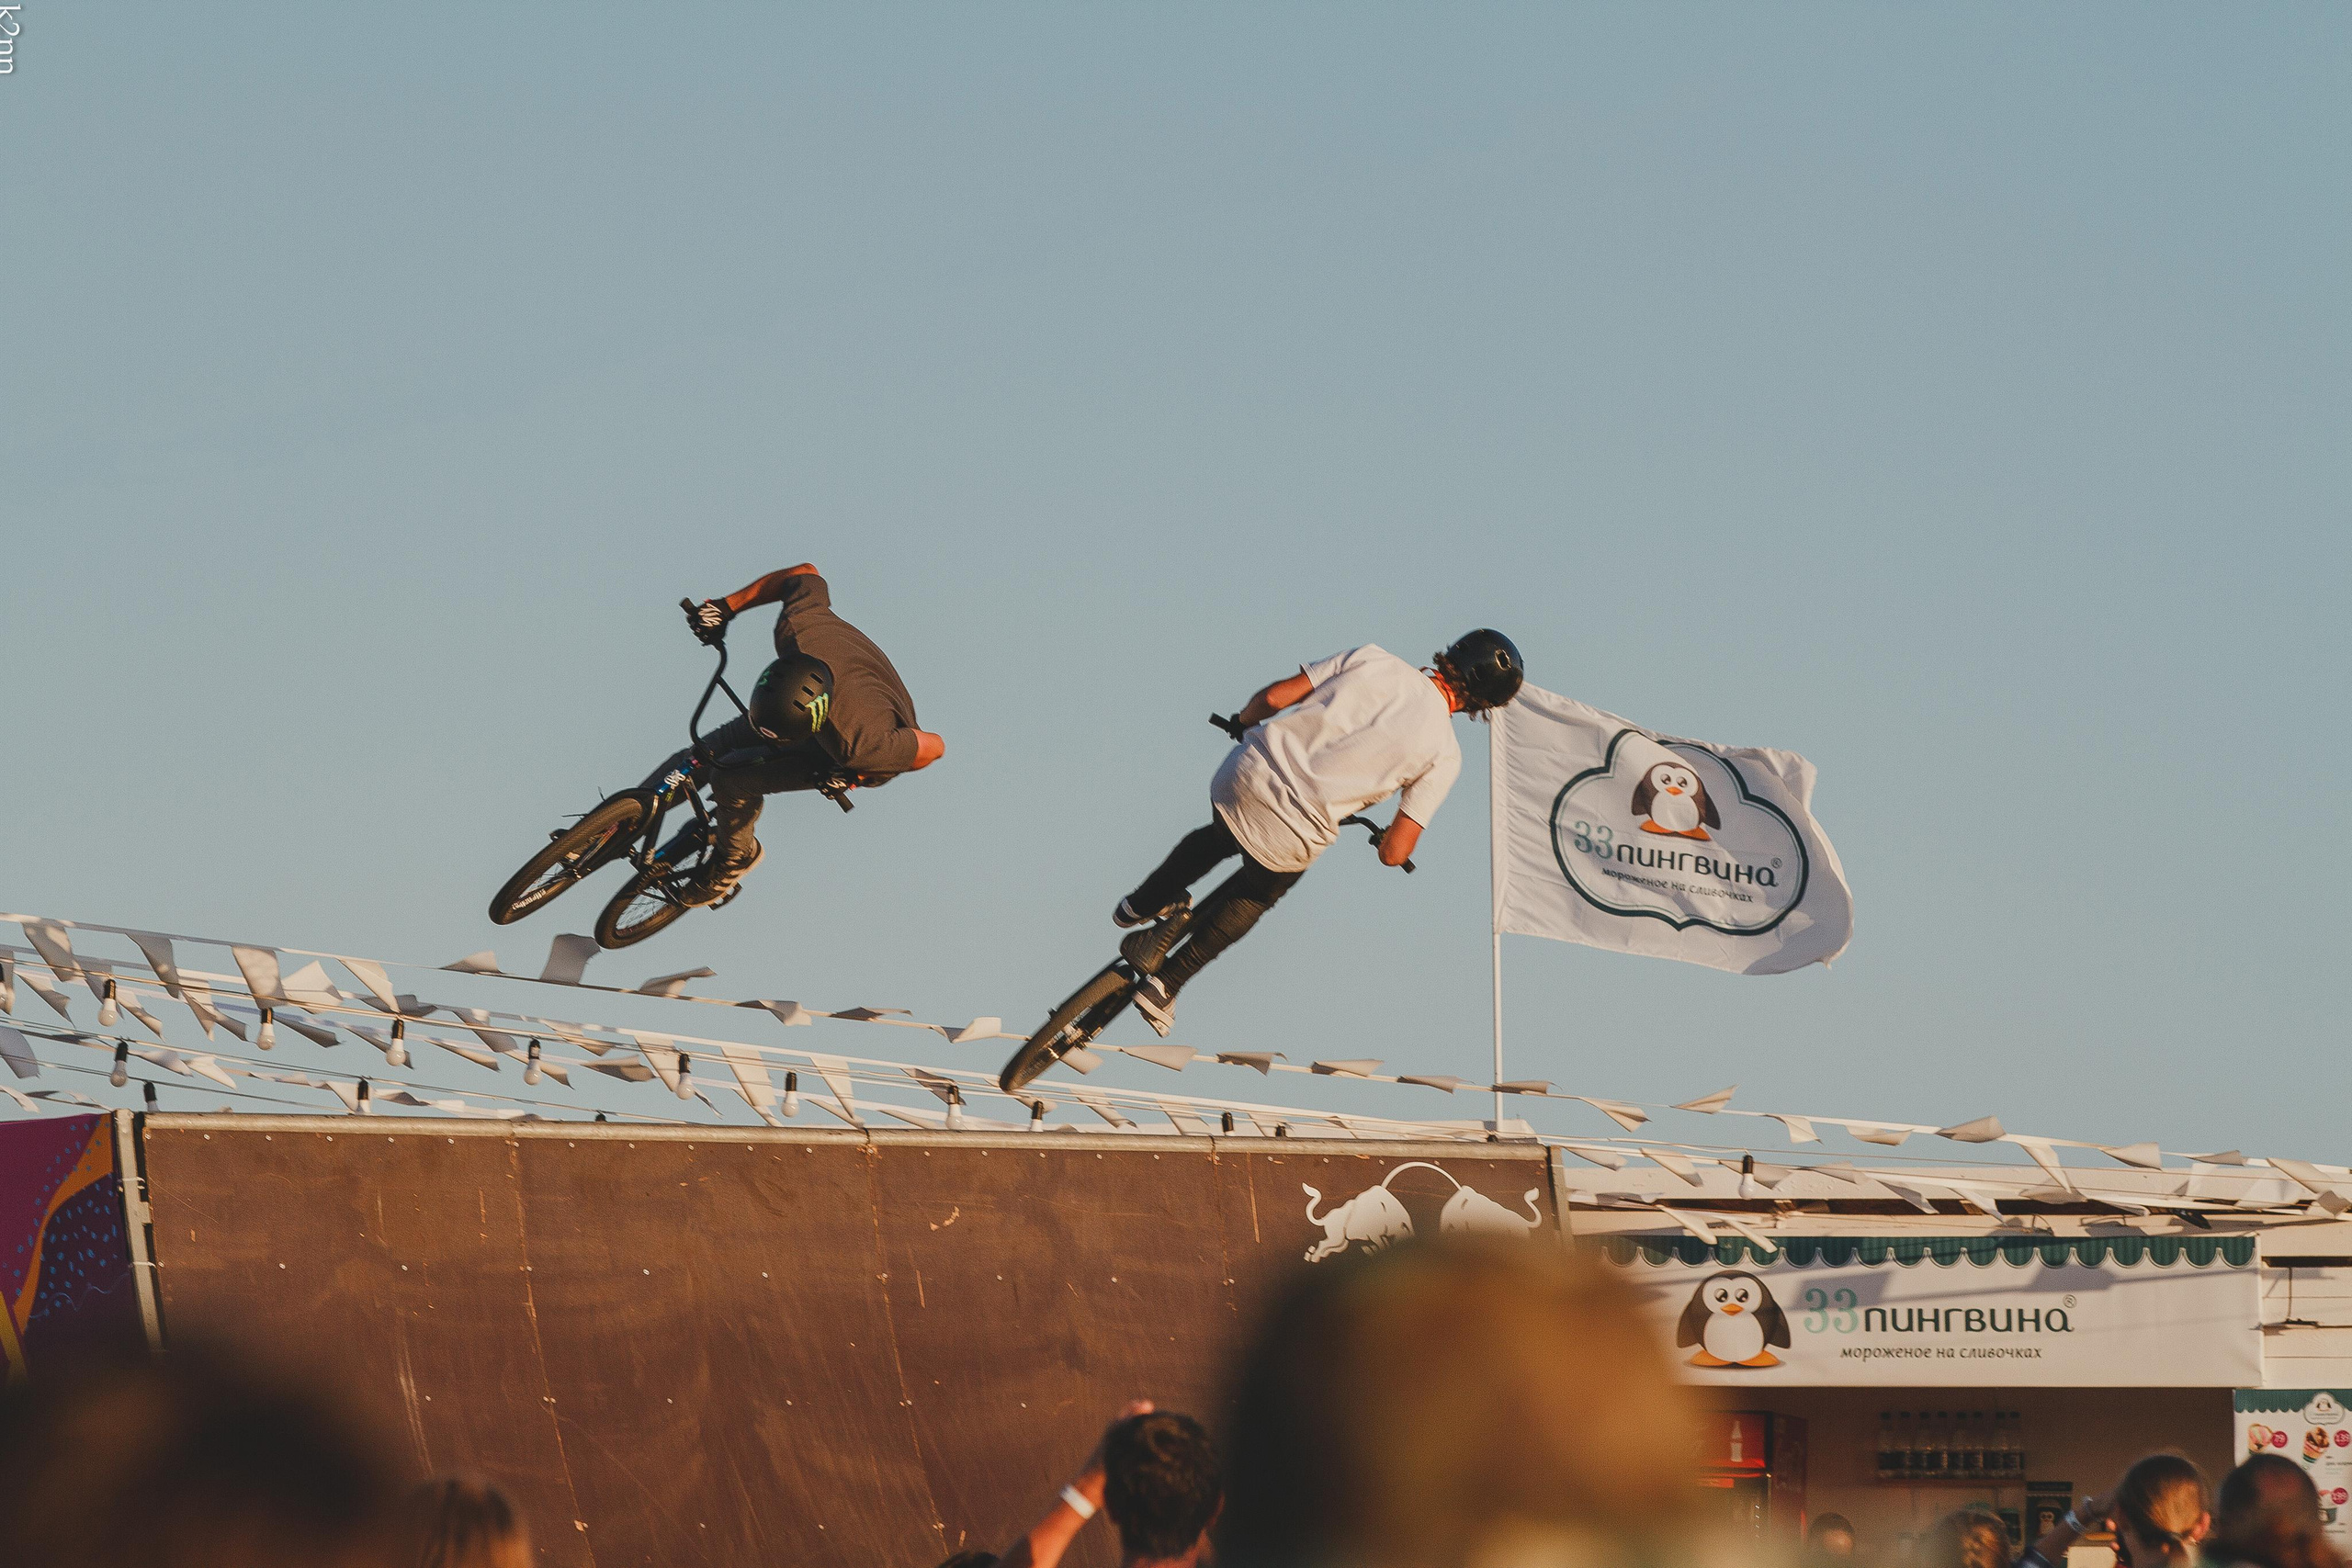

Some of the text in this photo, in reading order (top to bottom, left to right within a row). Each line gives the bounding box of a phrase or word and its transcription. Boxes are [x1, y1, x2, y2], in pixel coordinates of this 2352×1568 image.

[1601, 867, 1754, 903] мороженое на сливочках
[1840, 1347, 2041, 1362] мороженое на сливочках
